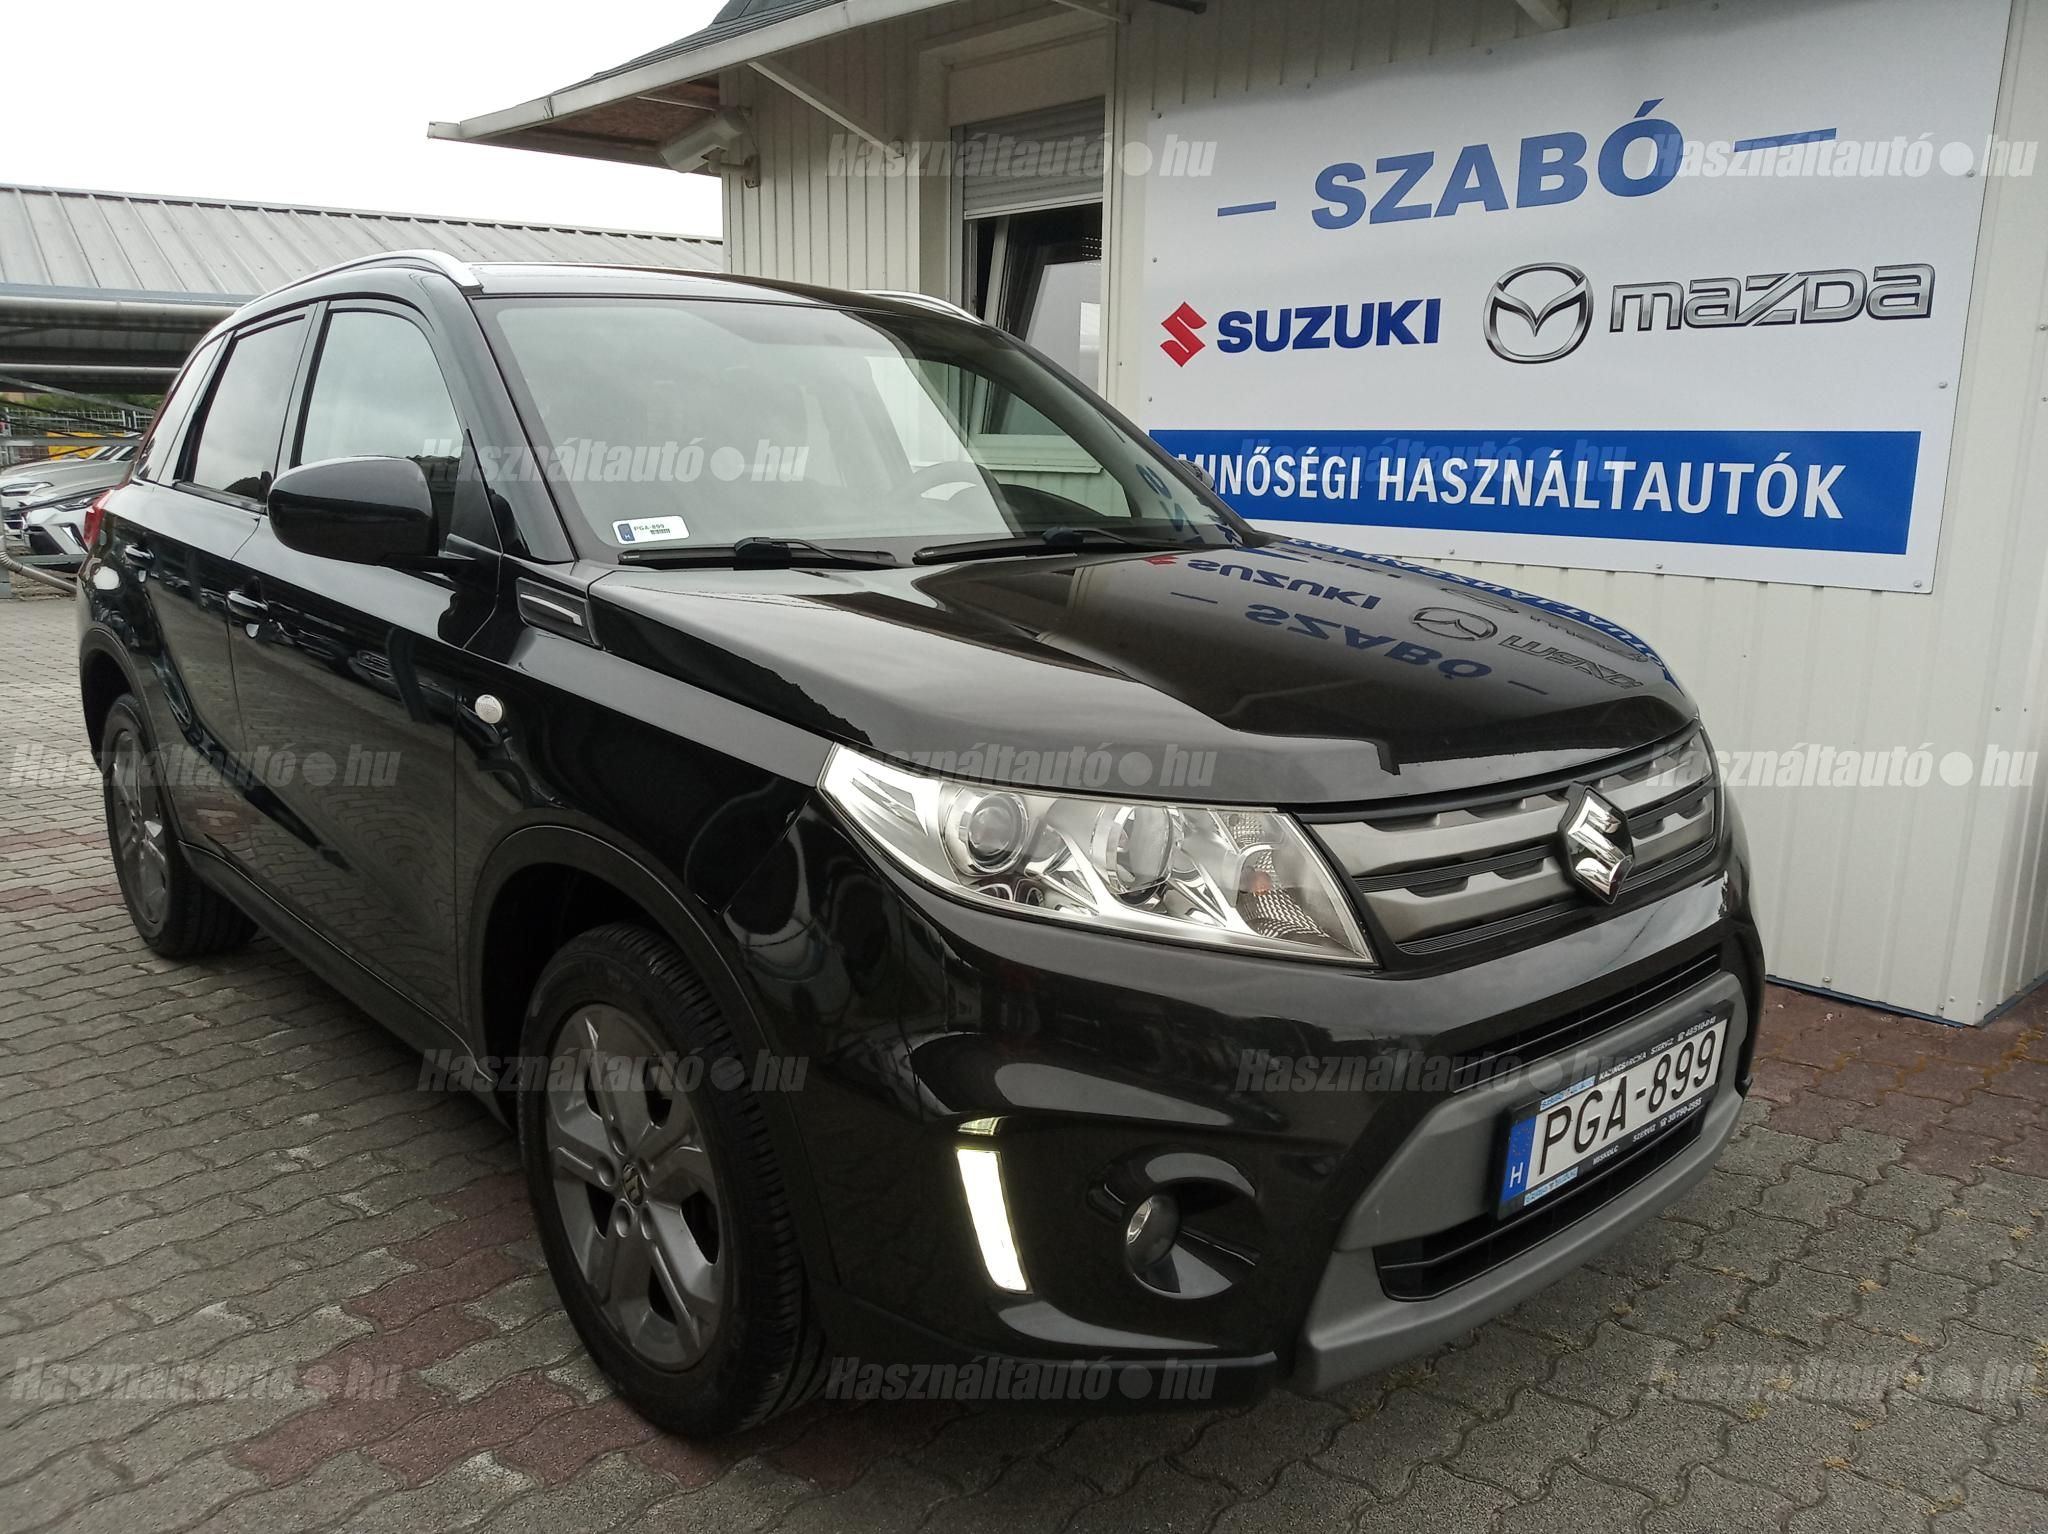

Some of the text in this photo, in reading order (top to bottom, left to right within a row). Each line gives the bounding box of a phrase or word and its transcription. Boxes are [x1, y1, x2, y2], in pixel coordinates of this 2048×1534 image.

[1311, 98, 1683, 230] SZABÓ
[1216, 298, 1441, 353] SUZUKI
[1376, 446, 1846, 519] HASZNÁLTAUTÓK
[1538, 1030, 1717, 1176] PGA-899
[1509, 1162, 1523, 1188] H
